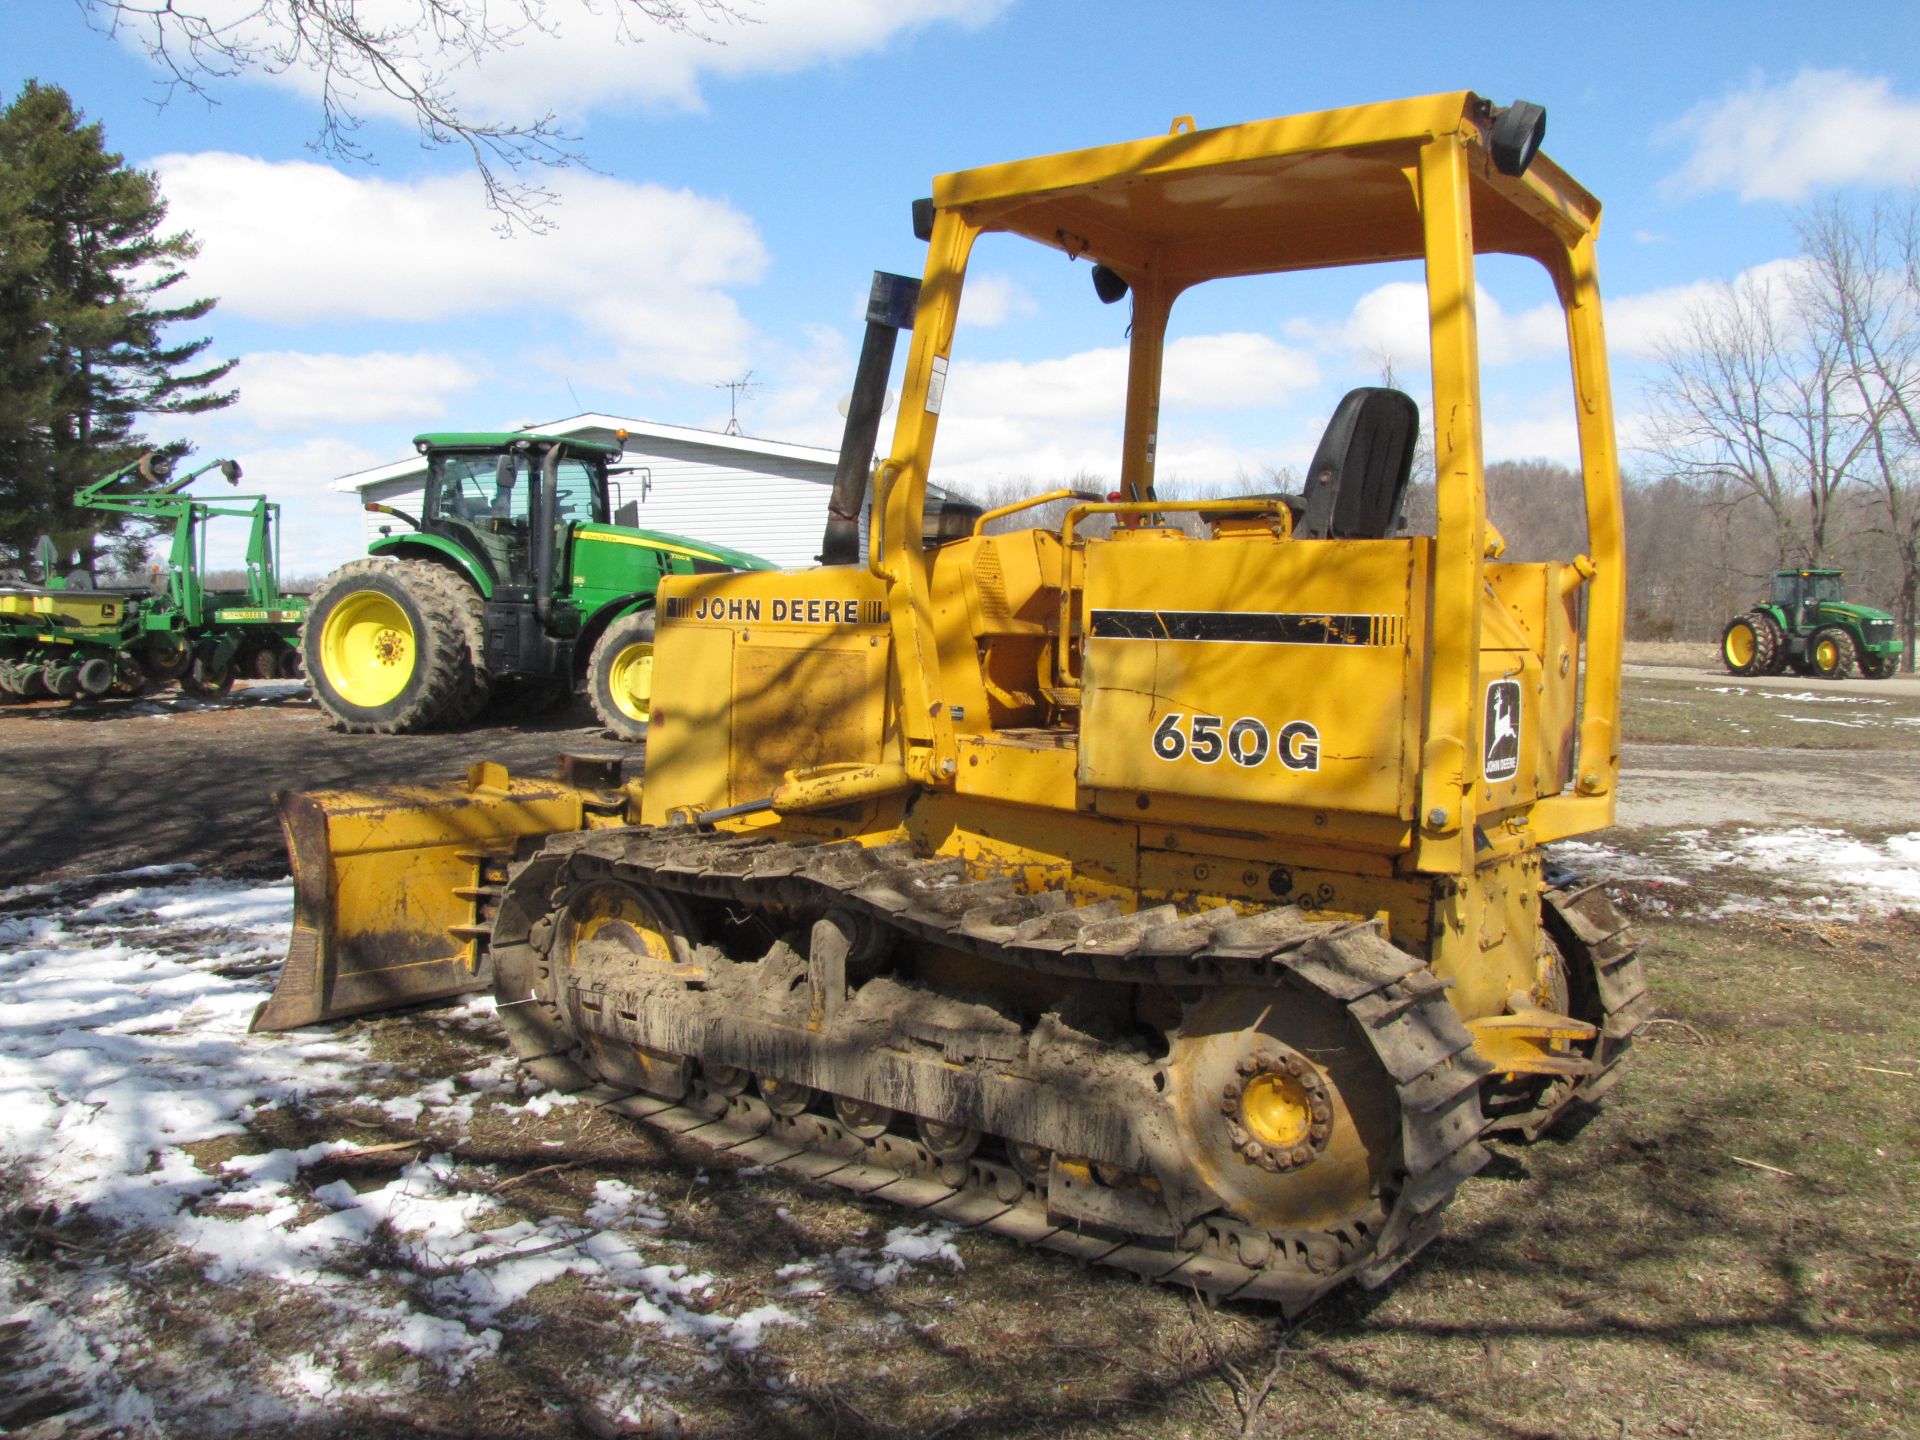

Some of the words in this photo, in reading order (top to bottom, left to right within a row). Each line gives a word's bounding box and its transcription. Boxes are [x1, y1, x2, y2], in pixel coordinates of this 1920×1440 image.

[695, 597, 761, 621] JOHN
[772, 598, 859, 624] DEERE
[1152, 713, 1320, 772] 650G
